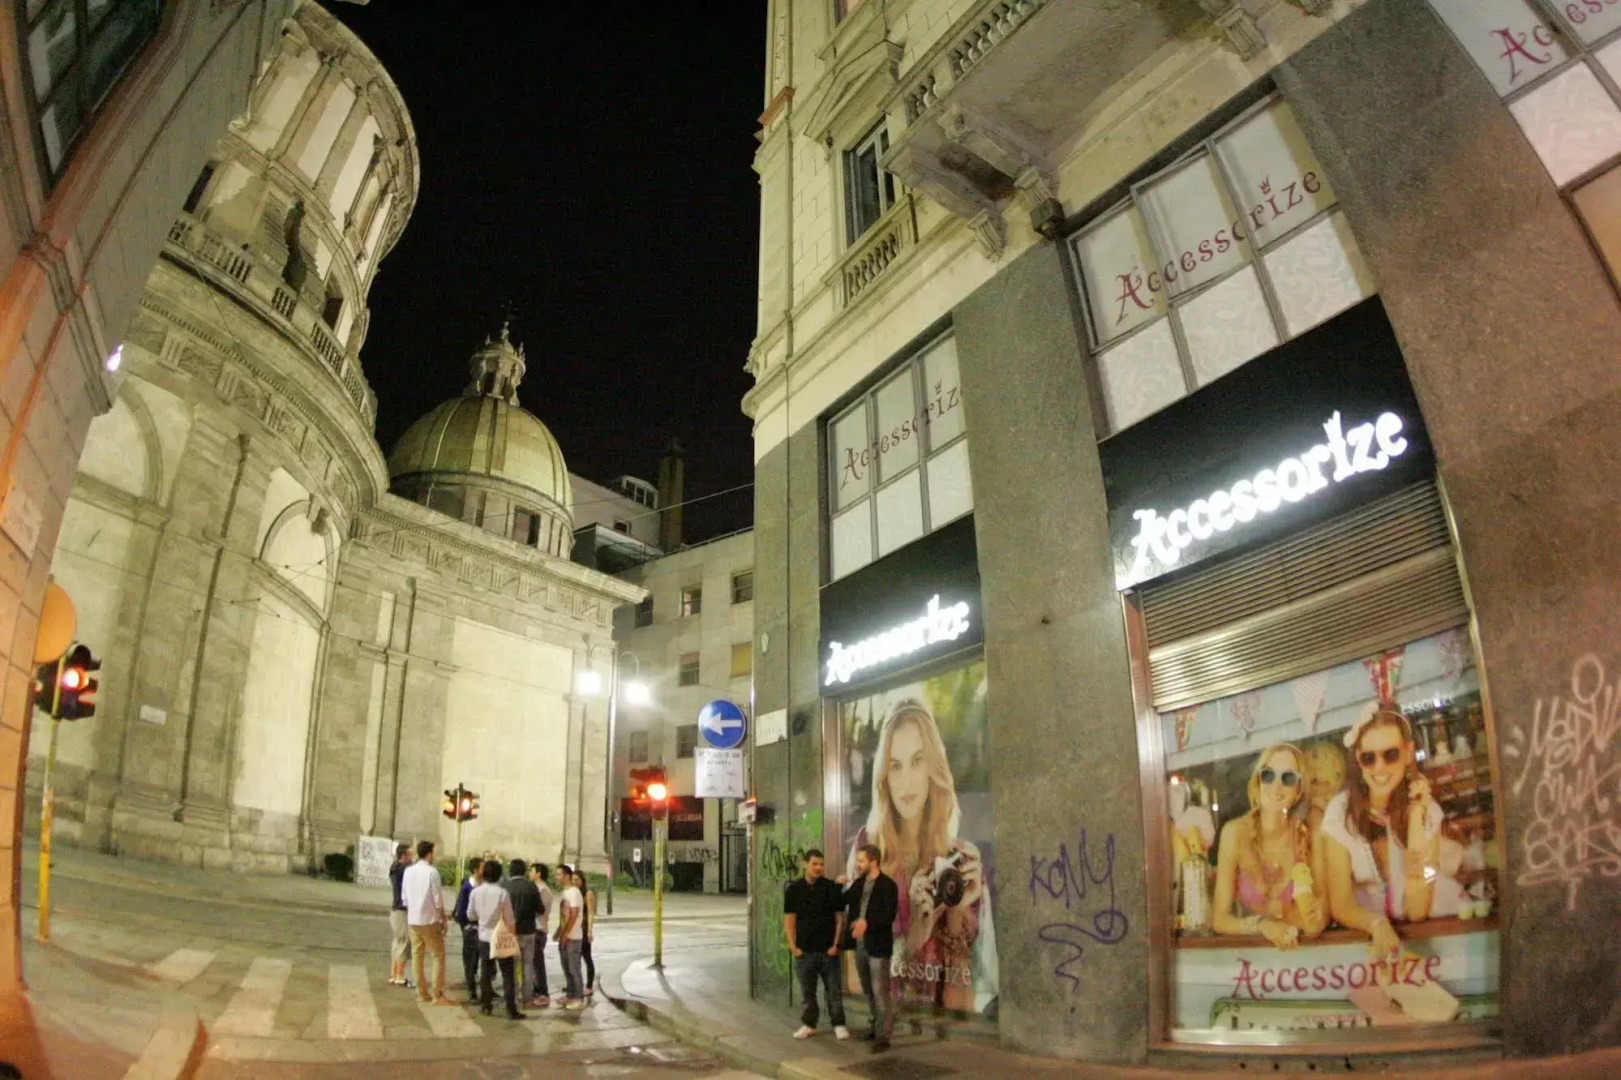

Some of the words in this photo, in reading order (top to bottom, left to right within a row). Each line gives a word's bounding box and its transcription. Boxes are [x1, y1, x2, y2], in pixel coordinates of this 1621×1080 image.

[1115, 171, 1322, 326] Accessorize
[1121, 410, 1408, 585] Accessorize
[1231, 945, 1443, 1003] Accessorize
